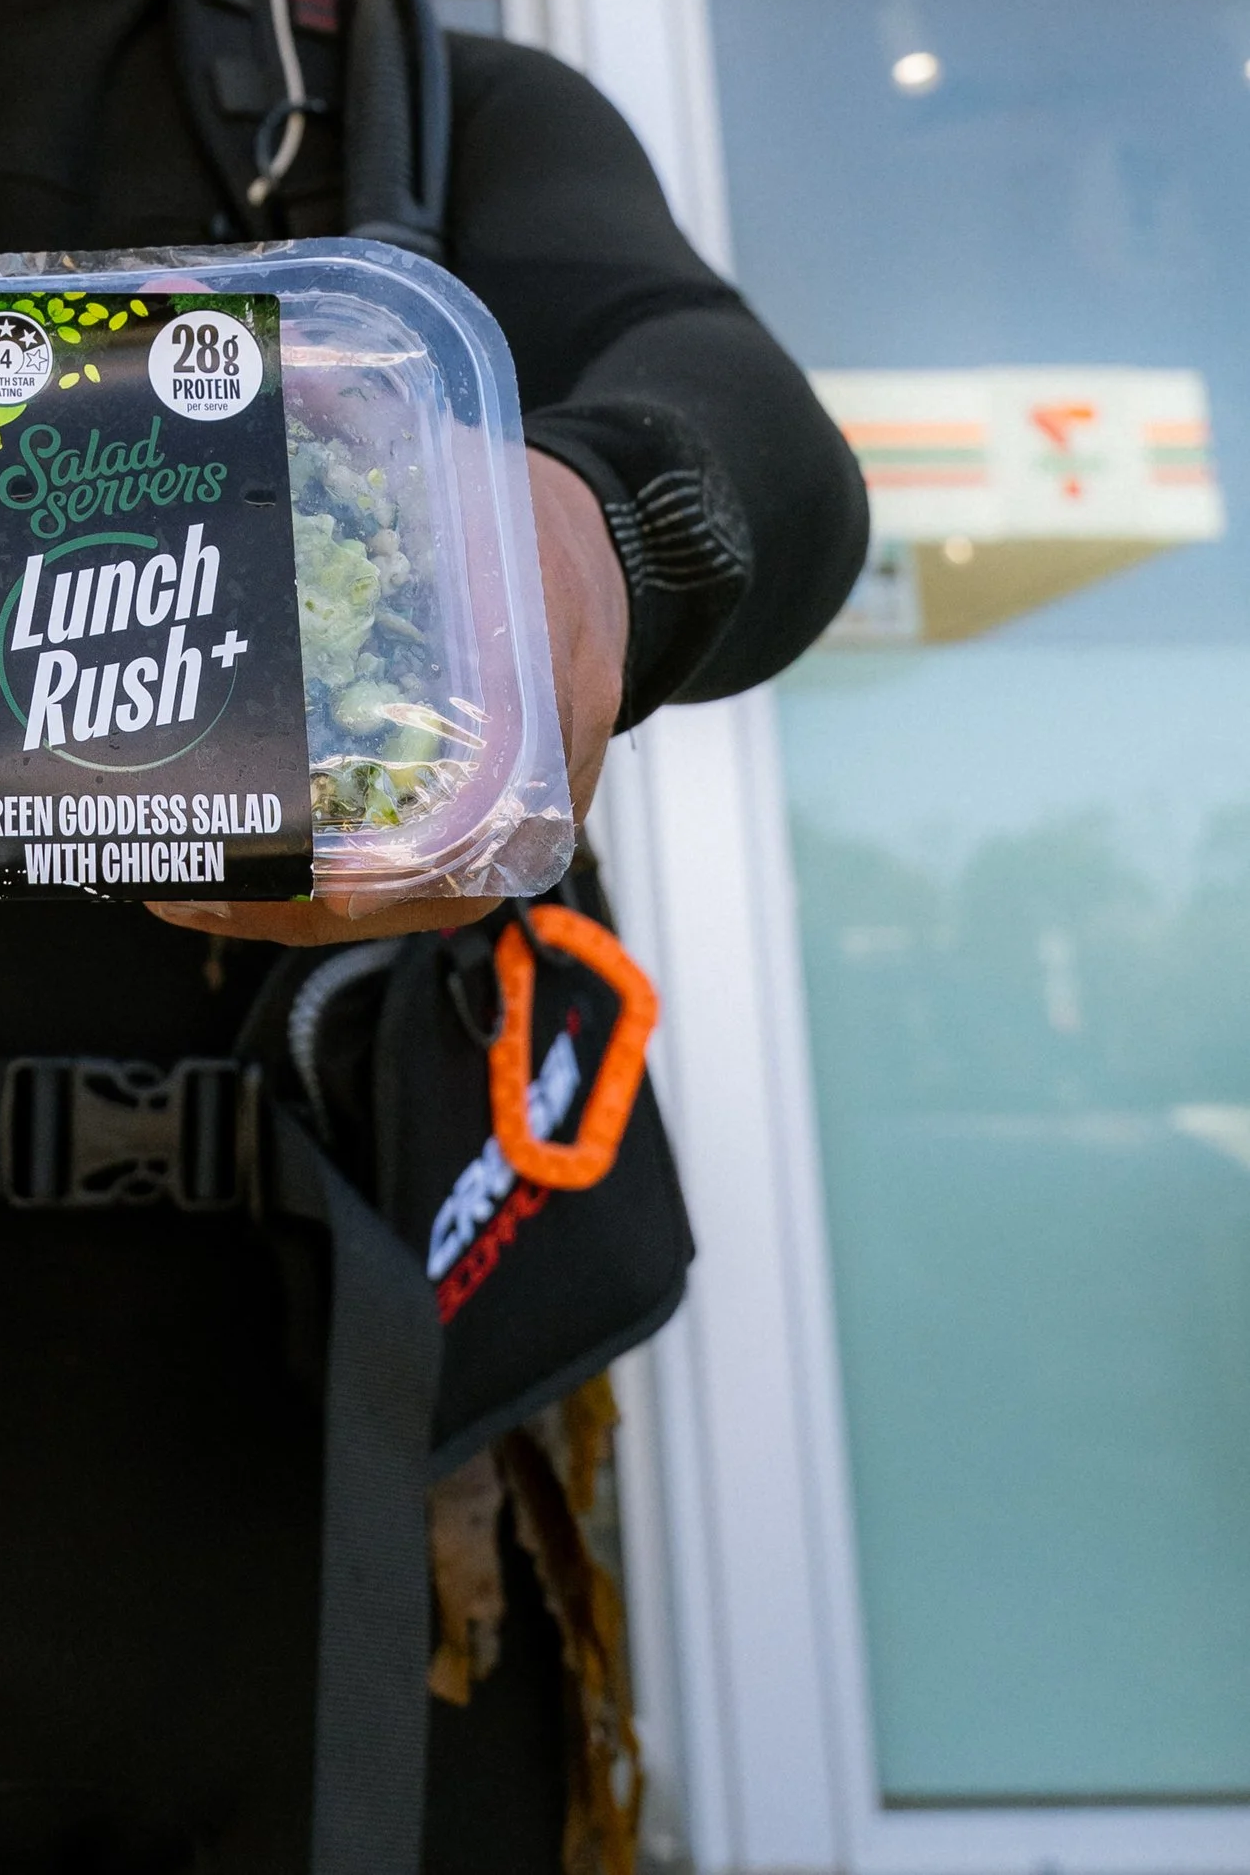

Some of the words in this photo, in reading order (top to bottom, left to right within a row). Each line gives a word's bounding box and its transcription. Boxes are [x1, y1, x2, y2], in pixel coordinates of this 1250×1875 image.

[0, 348, 13, 370] 4
[171, 323, 240, 377] 28g
[11, 376, 36, 387] STAR
[172, 378, 241, 400] PROTEIN
[187, 403, 201, 413] per
[204, 402, 229, 412] serve
[10, 522, 221, 652] Lunch
[58, 794, 187, 837] GODDESS
[191, 793, 282, 835] SALAD
[24, 843, 97, 885] WITH
[101, 841, 225, 883] CHICKEN
